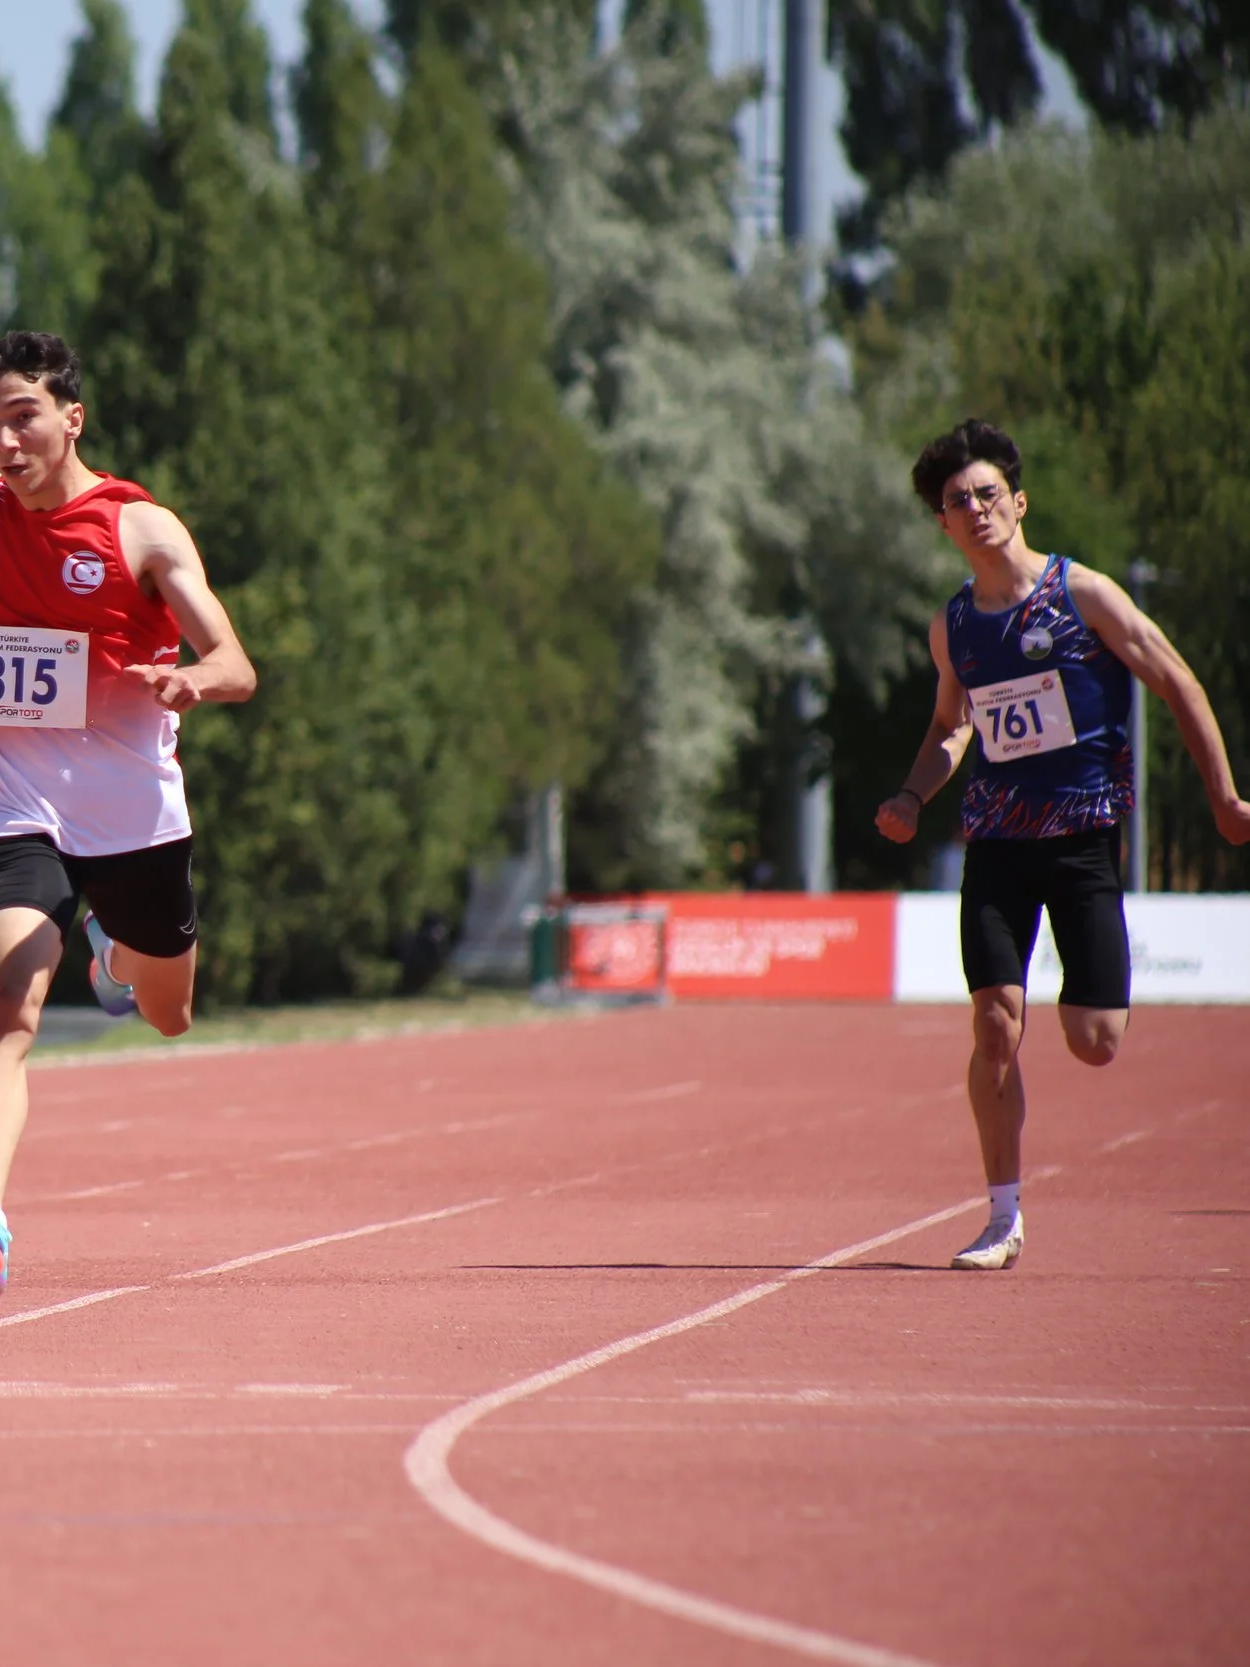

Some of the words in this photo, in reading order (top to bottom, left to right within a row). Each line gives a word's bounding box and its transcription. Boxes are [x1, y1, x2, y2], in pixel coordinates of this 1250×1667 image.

[0, 634, 30, 643] TÜRKİYE
[5, 644, 63, 654] FEDERASYONU
[986, 699, 1044, 744] 761
